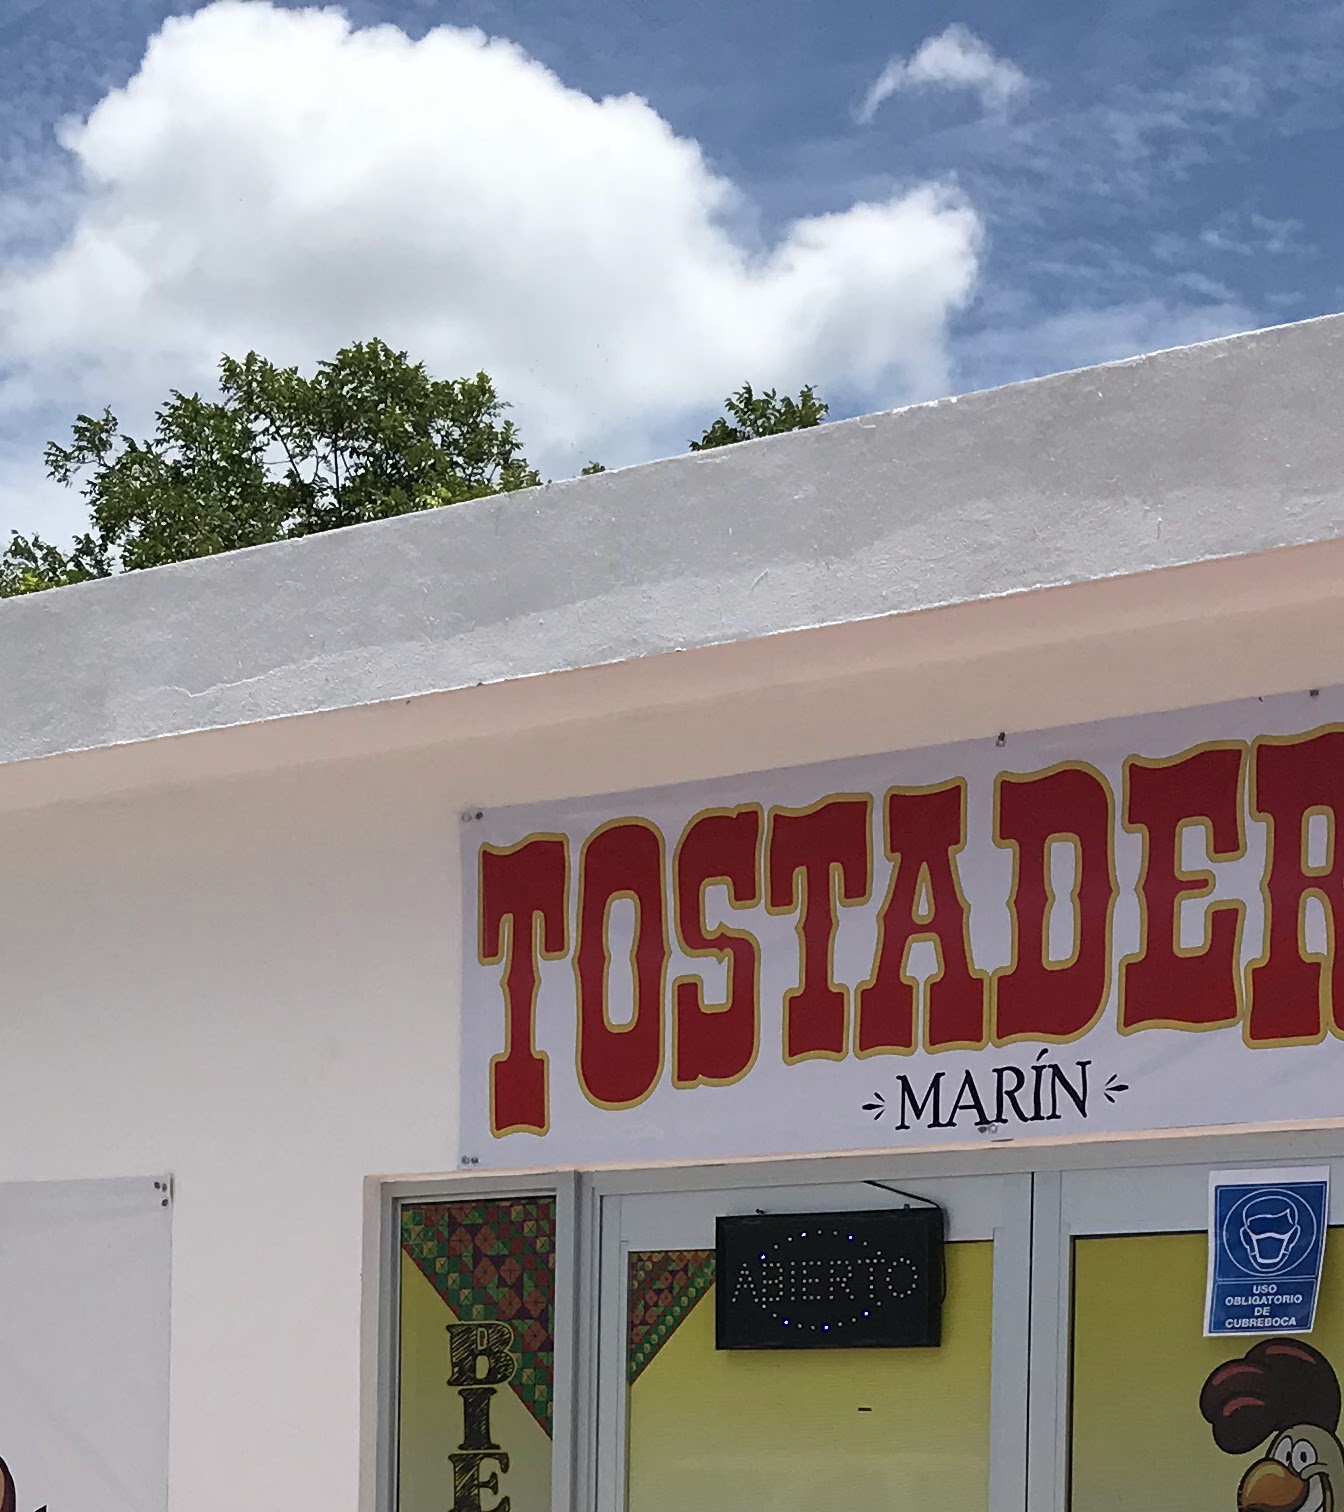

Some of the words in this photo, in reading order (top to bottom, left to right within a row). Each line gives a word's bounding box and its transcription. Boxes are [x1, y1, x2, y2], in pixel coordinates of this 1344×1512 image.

[895, 1048, 1095, 1131] MARÍN
[731, 1257, 918, 1302] ABIERTO
[1253, 1284, 1277, 1293] USO
[1225, 1294, 1303, 1306] OBLIGATORIO
[1254, 1306, 1270, 1316] DE
[1225, 1317, 1297, 1329] CUBREBOCA
